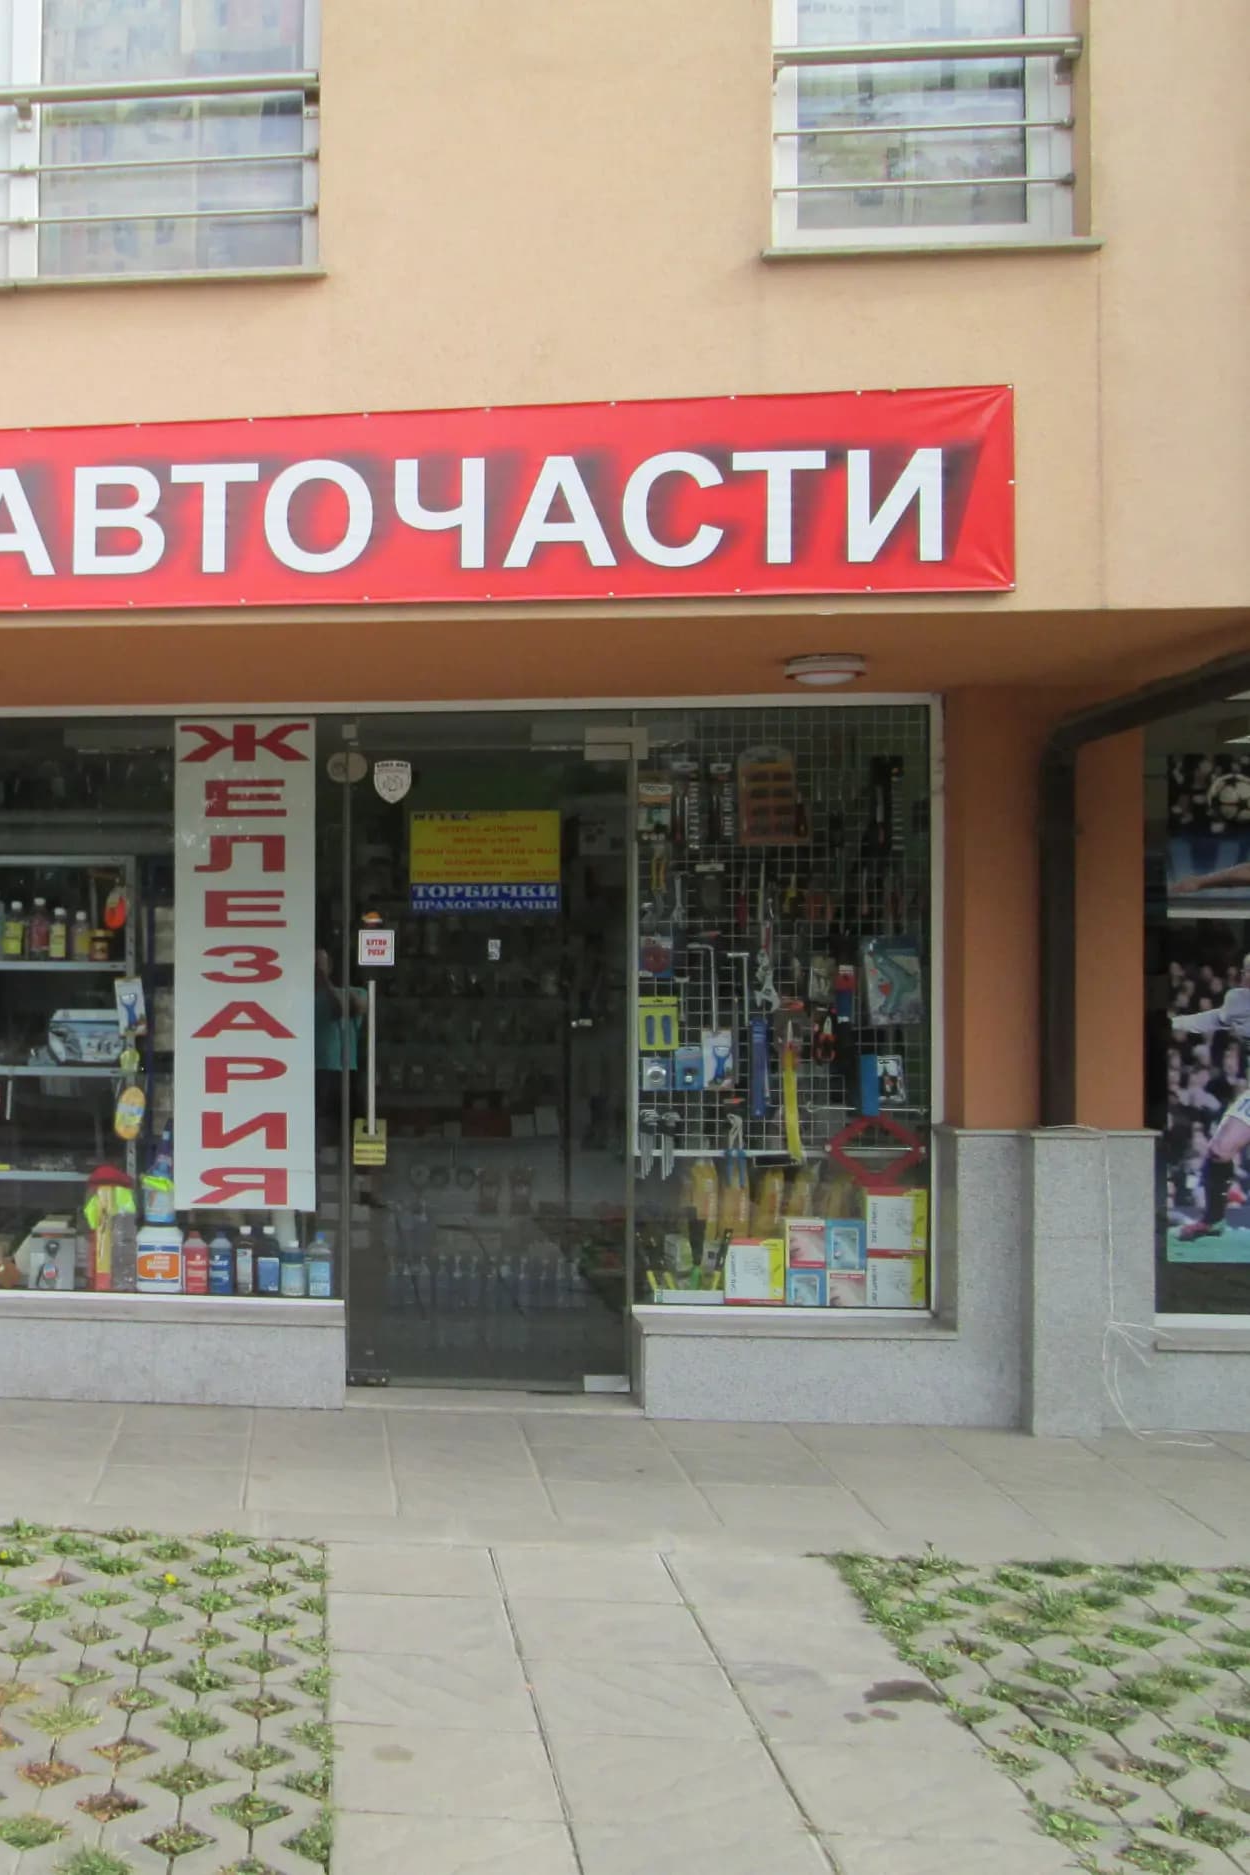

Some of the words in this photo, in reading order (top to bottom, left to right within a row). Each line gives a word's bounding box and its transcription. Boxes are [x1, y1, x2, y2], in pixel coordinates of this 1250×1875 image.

[414, 885, 557, 898] ТОРБИЧКИ
[413, 900, 558, 910] ПРАХОСМУКАЧКИ
[178, 722, 311, 1206] ЖЕЛЕЗАРИЯ
